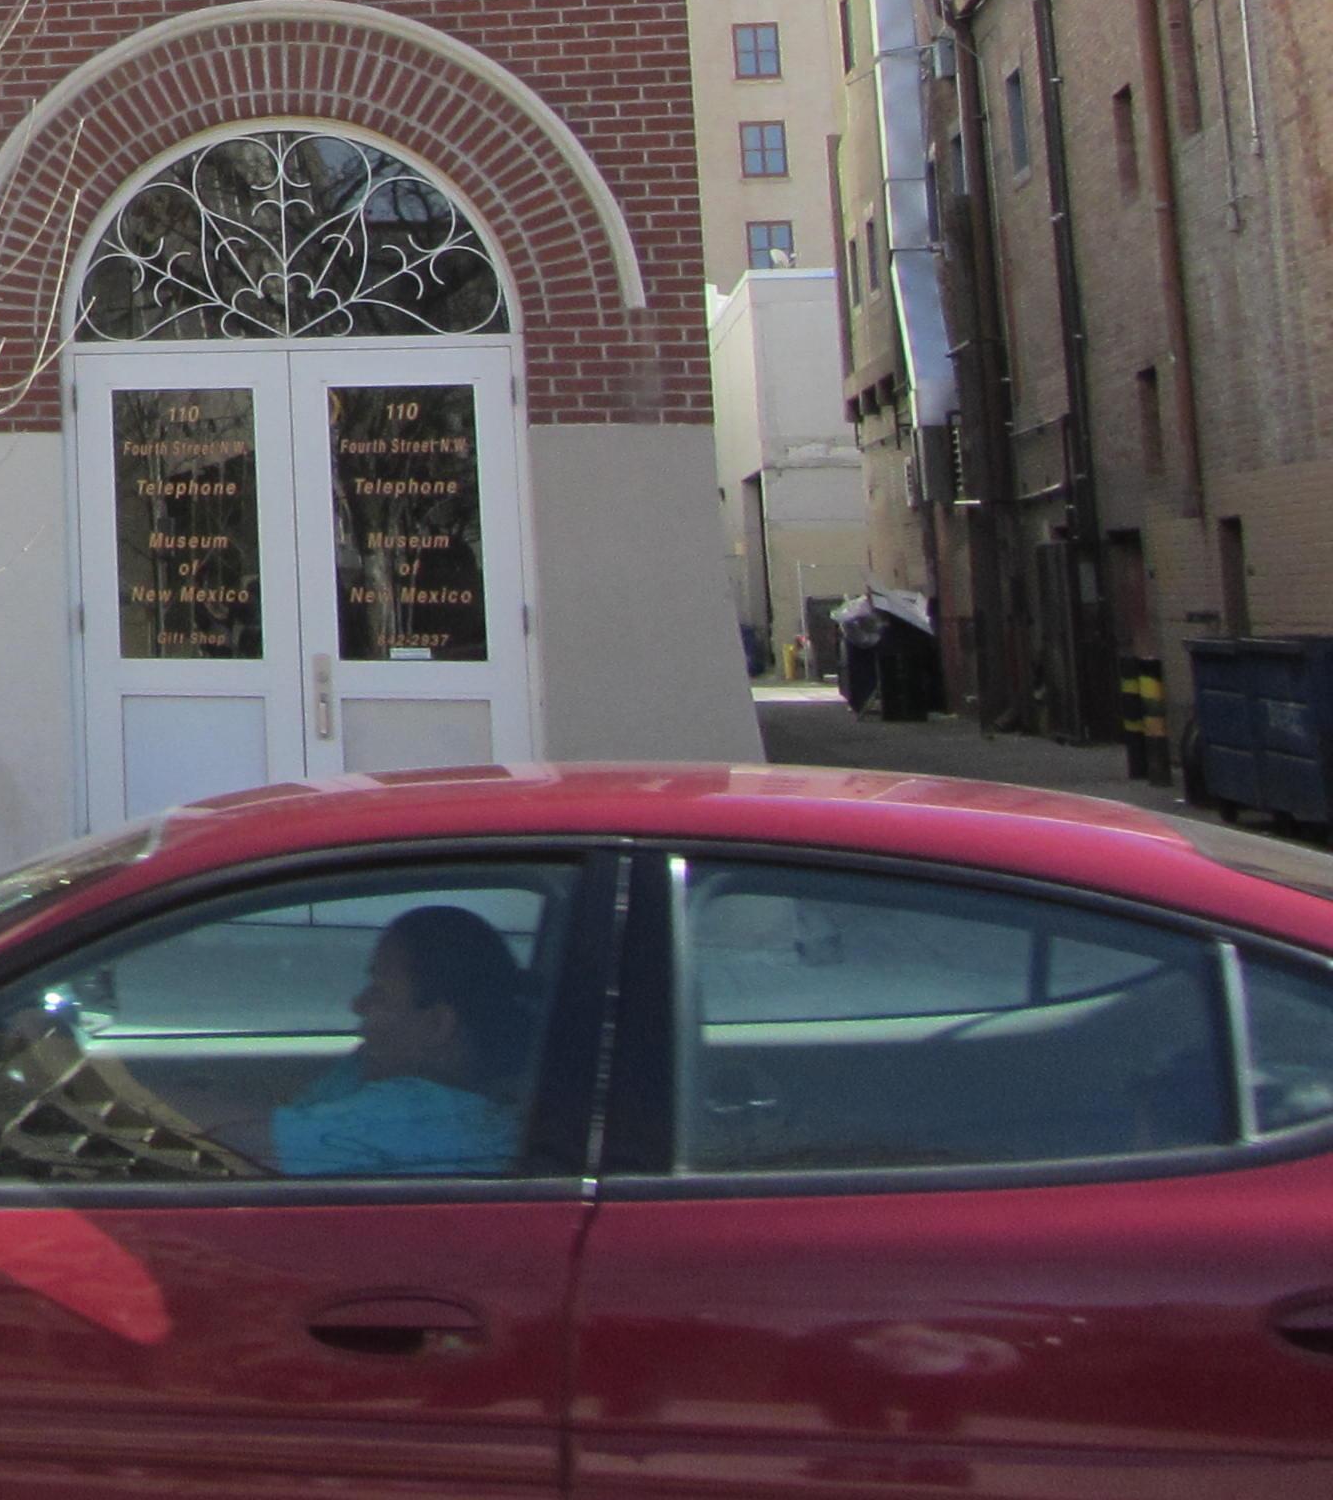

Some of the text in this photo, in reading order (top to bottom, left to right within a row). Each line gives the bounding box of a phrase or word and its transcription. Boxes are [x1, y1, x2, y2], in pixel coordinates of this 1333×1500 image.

[168, 405, 200, 423] 110
[386, 402, 419, 420] 110
[123, 440, 167, 456] Fourth
[172, 440, 214, 455] Street
[340, 438, 386, 454] Fourth
[391, 438, 435, 453] Street
[136, 479, 237, 500] Telephone
[354, 477, 458, 499] Telephone
[149, 531, 229, 549] Museum
[367, 531, 450, 549] Museum
[179, 559, 200, 576] of
[399, 559, 421, 576] of
[131, 586, 250, 603] New Mexico
[350, 586, 473, 604] New Mexico
[157, 631, 226, 646] Gift Shop
